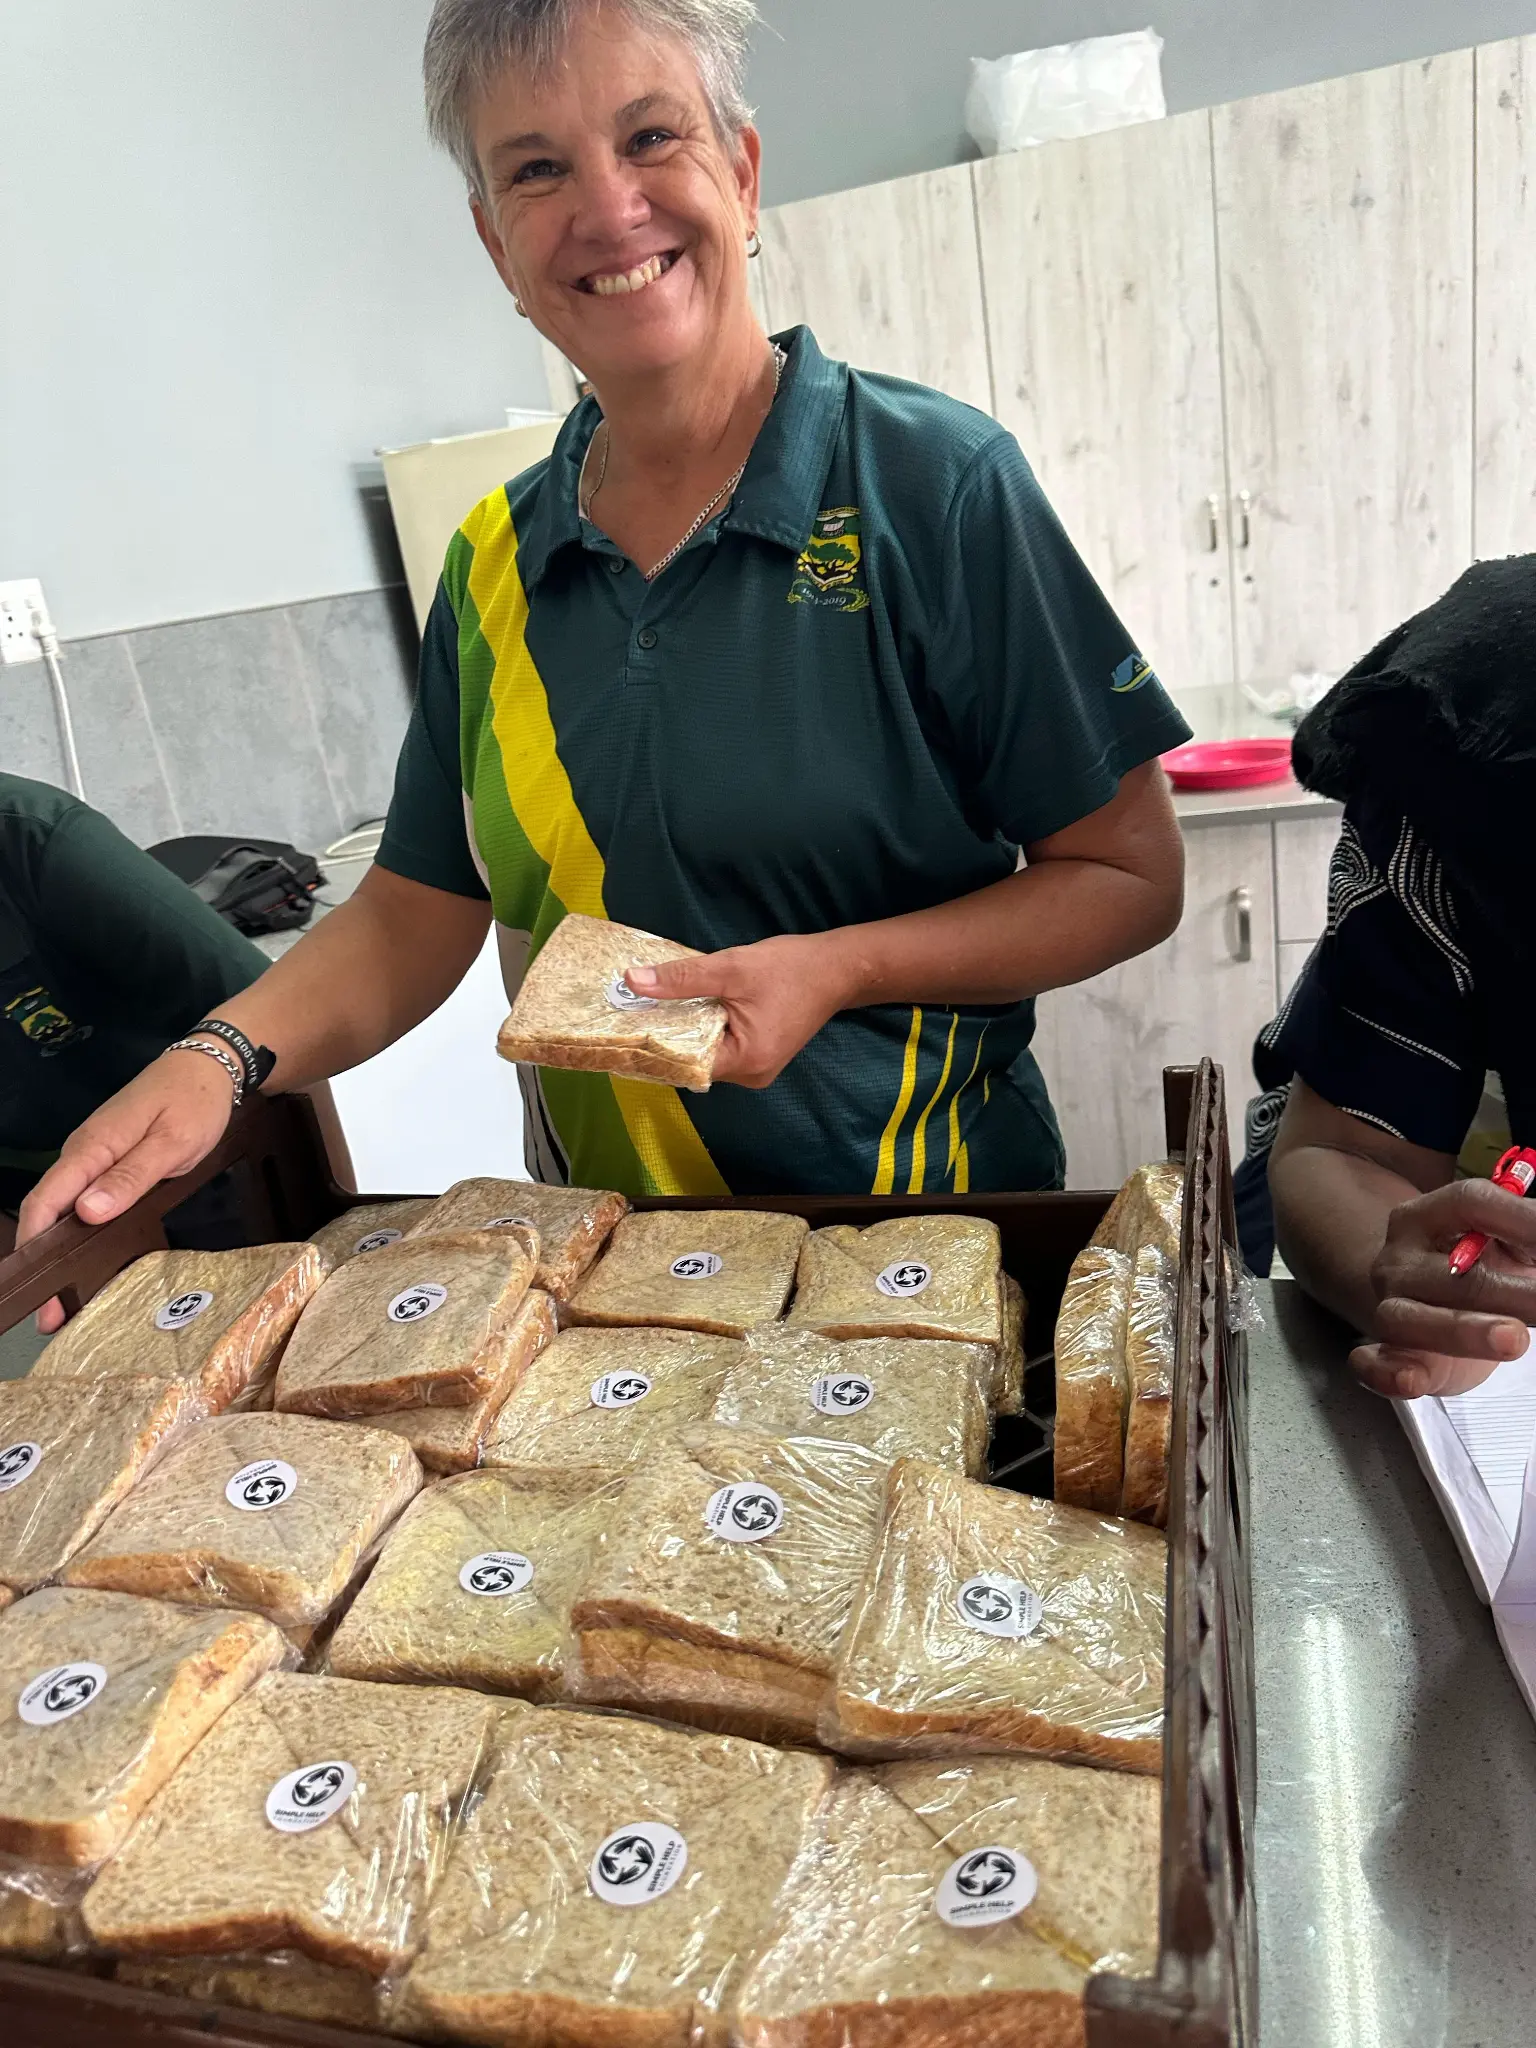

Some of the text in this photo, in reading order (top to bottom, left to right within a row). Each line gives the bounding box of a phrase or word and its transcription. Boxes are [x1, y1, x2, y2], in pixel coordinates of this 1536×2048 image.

[208, 1022, 235, 1037] 911
[274, 1808, 304, 1818] SIMPLE
[647, 1840, 676, 1892] SIMPLE HELP
[949, 1900, 1015, 1914] SIMPLE HELP
